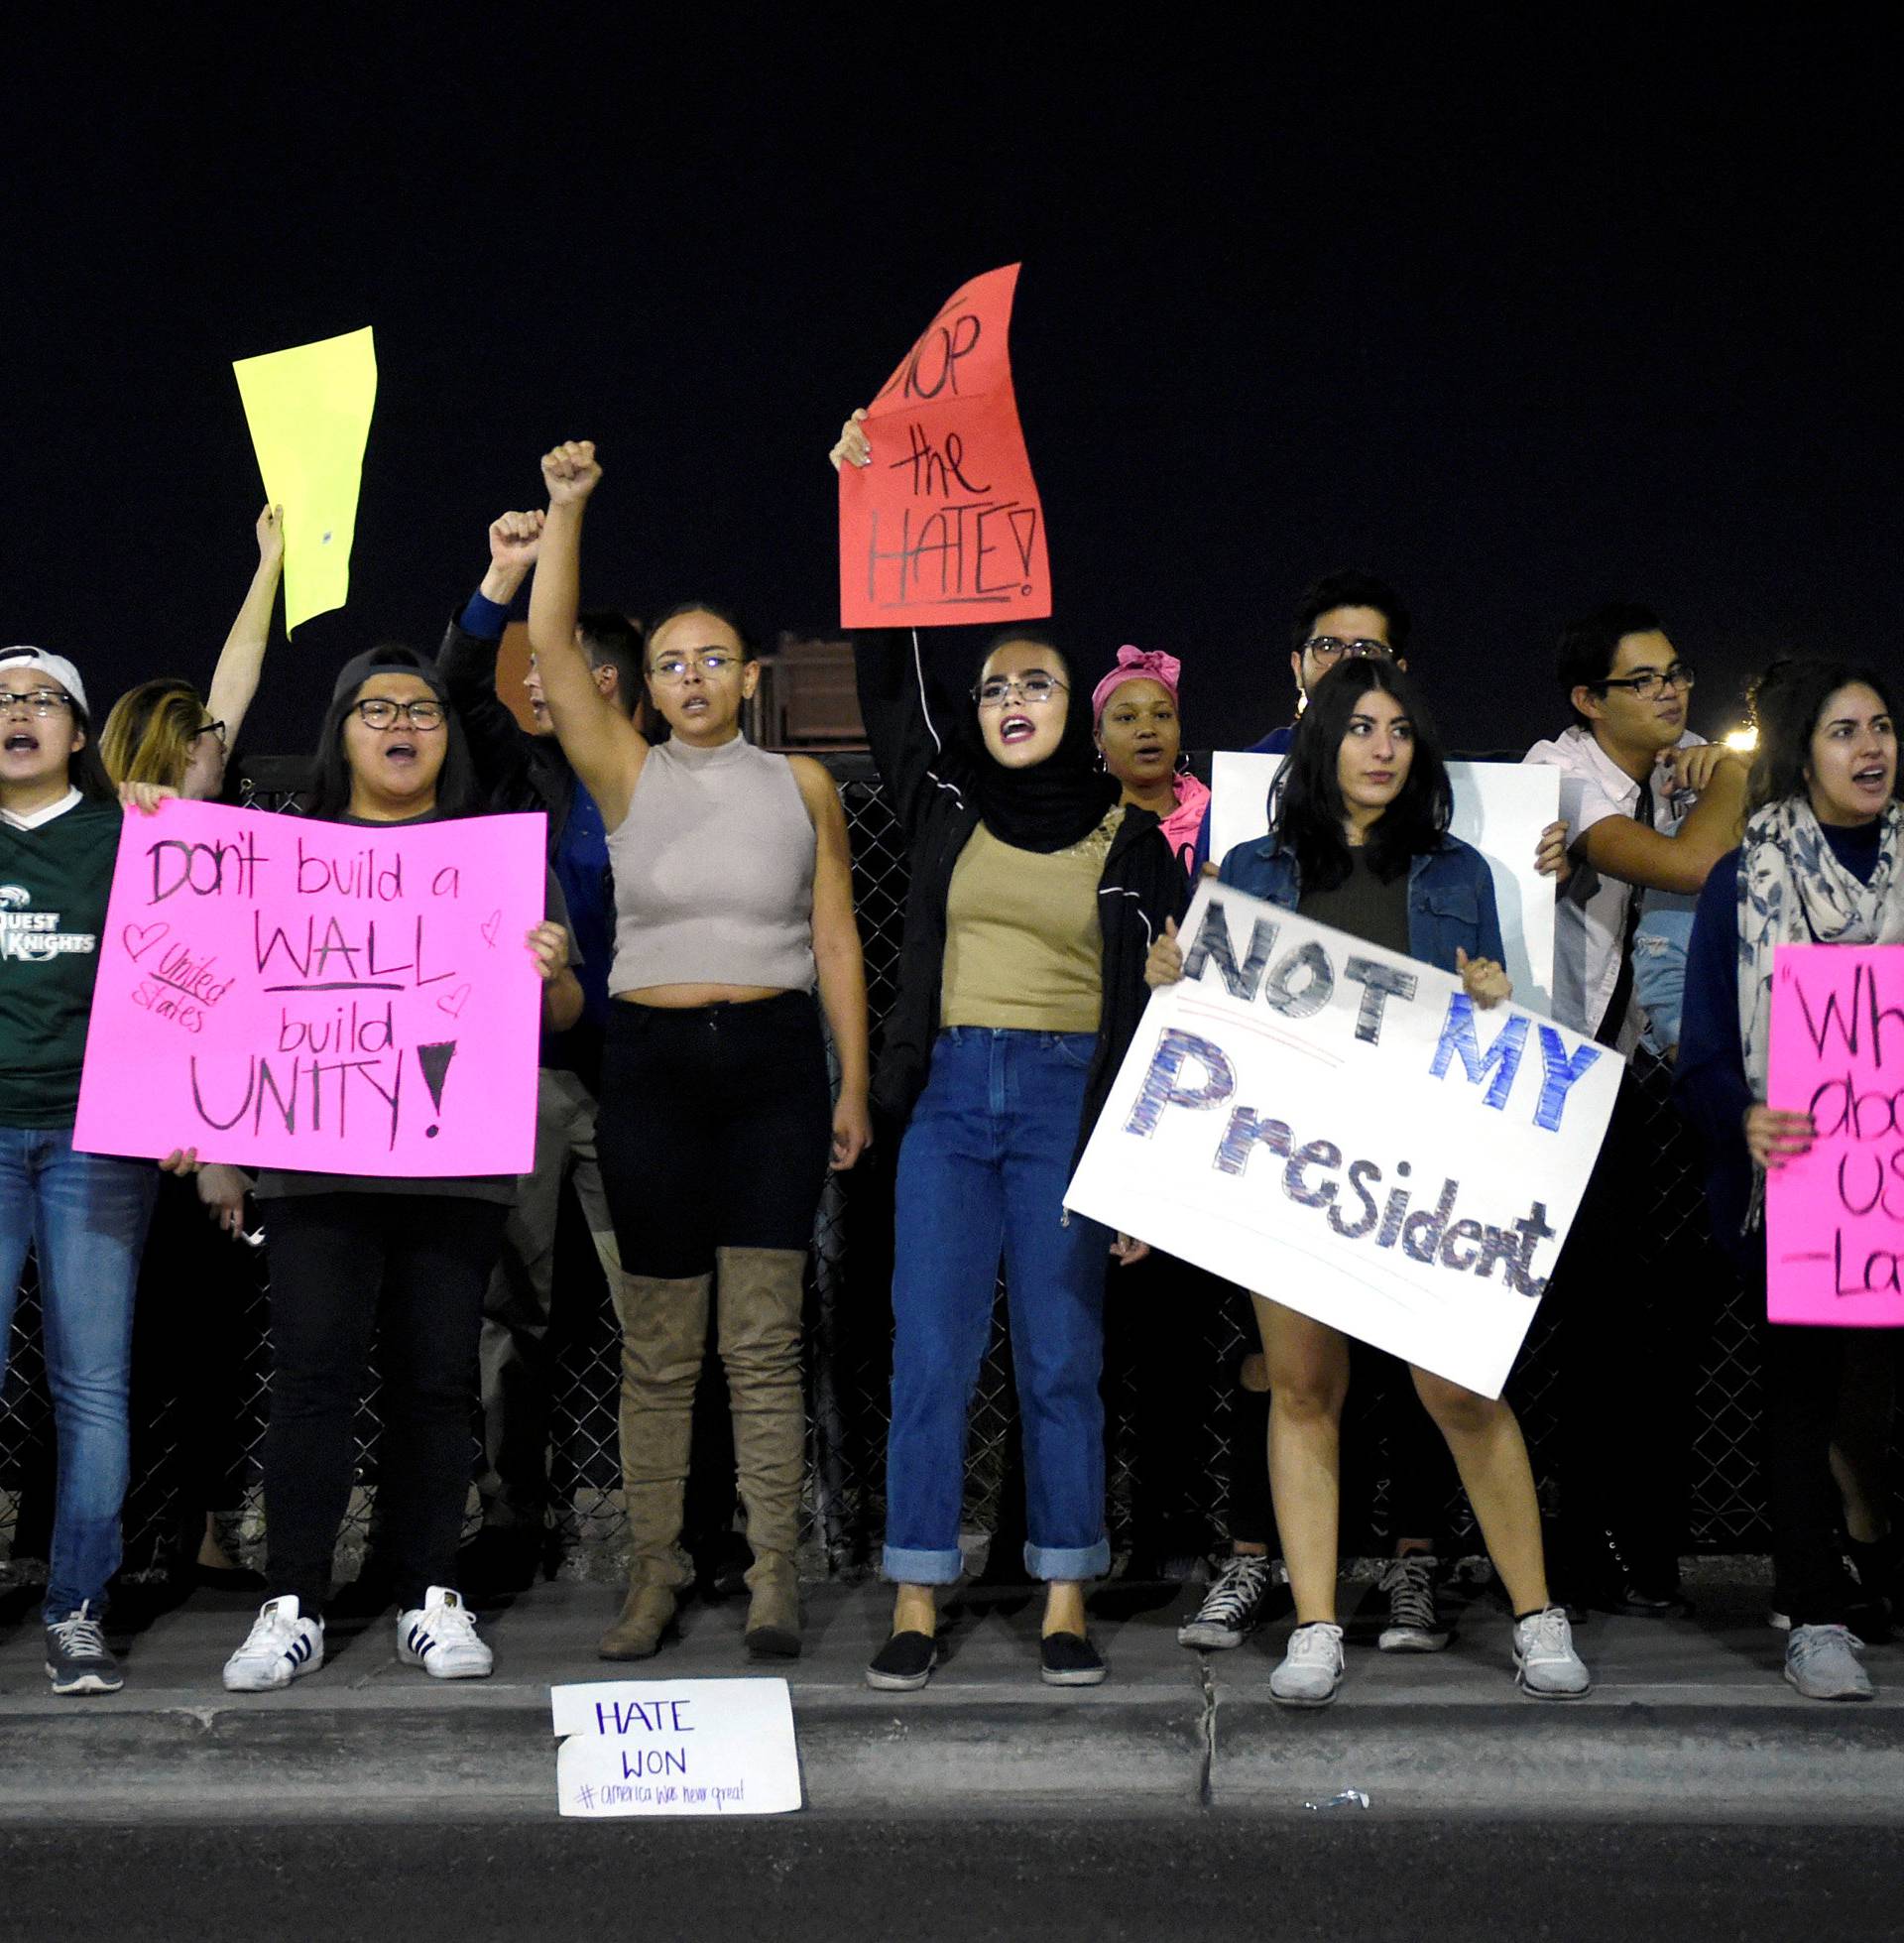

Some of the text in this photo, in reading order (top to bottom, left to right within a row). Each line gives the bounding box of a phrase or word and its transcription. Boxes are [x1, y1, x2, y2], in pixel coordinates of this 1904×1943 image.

[877, 297, 981, 399] TOP
[890, 424, 991, 499] the
[869, 502, 1036, 603] HATE!
[146, 831, 459, 906] Don't build a
[159, 942, 235, 1004] United
[255, 910, 456, 986] WALL
[279, 1001, 393, 1053] build
[1183, 899, 1602, 1133] NOT MY
[1122, 1027, 1557, 1297] President
[595, 1699, 695, 1735] HATE
[622, 1747, 686, 1779] WON
[711, 1778, 745, 1812] great
